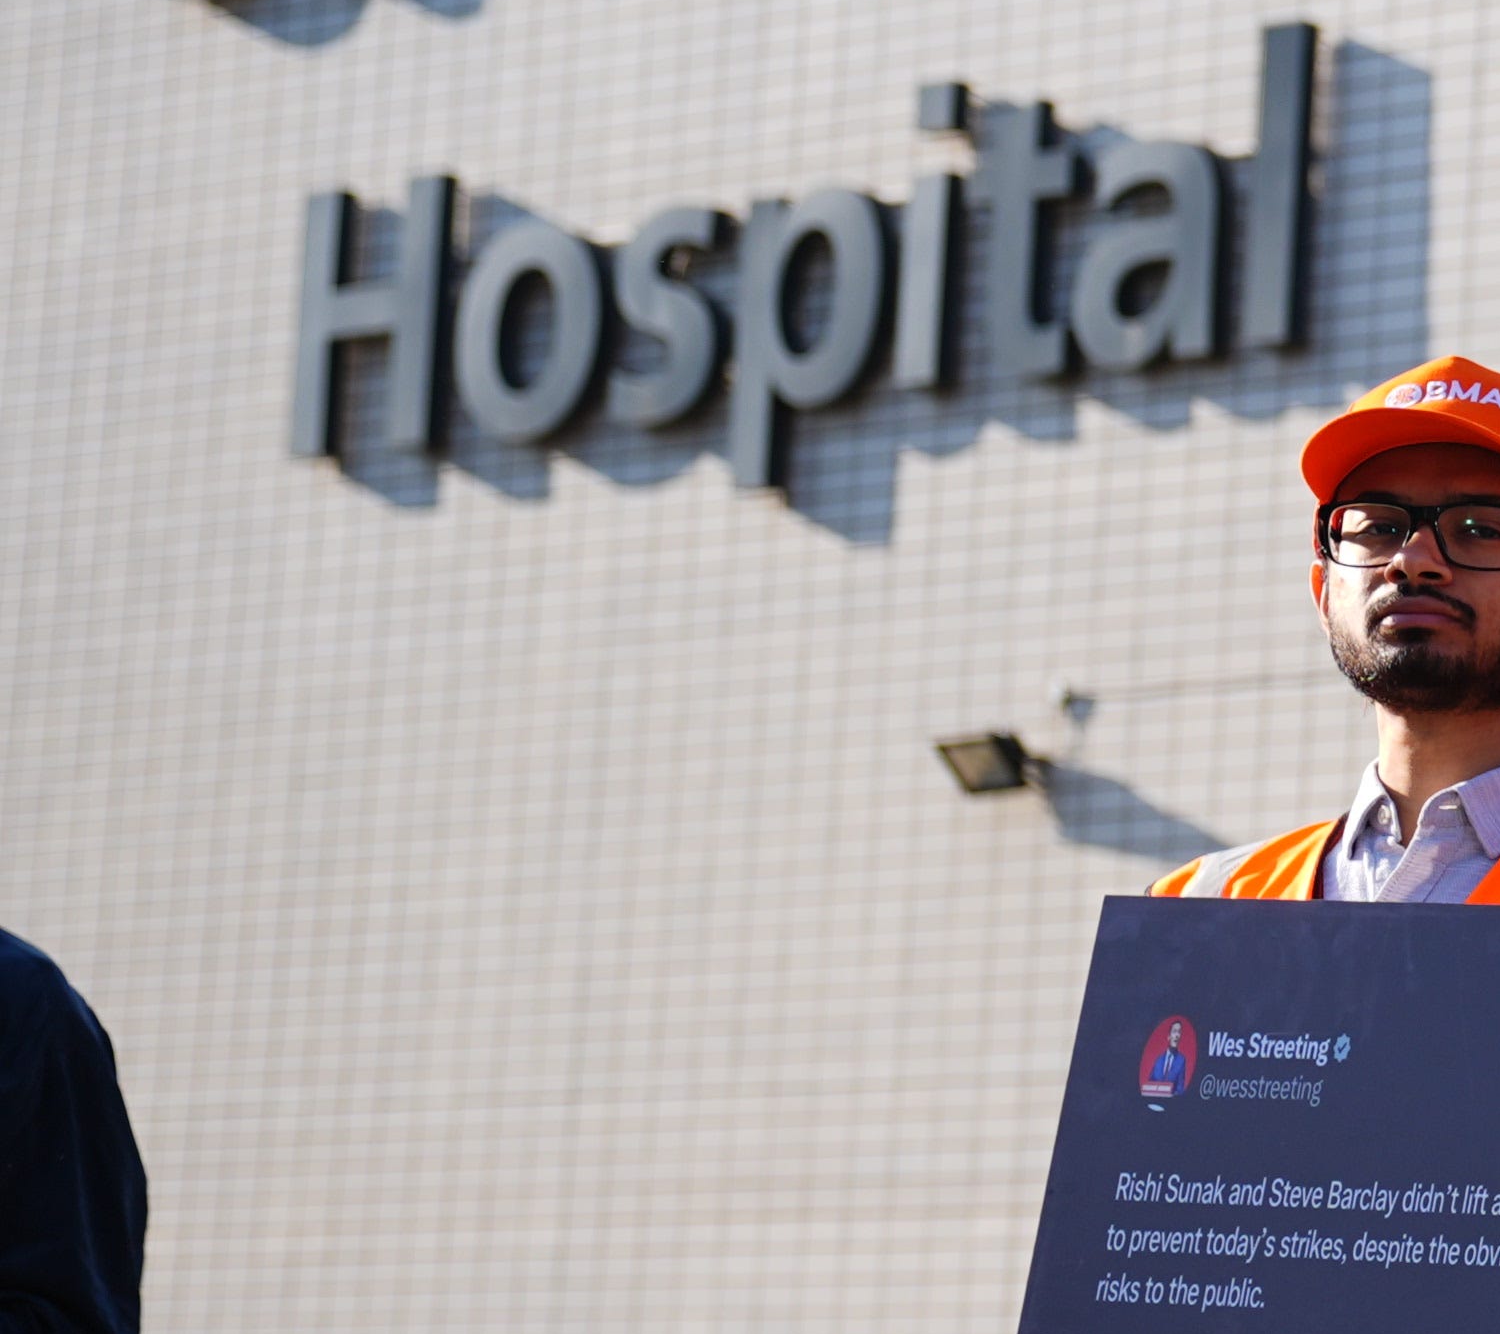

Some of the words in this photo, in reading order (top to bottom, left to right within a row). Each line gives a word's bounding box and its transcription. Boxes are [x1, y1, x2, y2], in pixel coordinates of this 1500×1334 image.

[288, 22, 1326, 491] Hospital
[1208, 1031, 1245, 1058] Wes
[1247, 1032, 1331, 1067] Streeting
[1199, 1073, 1324, 1108] @wesstreeting
[1115, 1172, 1164, 1202] Rishi
[1164, 1173, 1226, 1205] Sunak
[1228, 1176, 1267, 1207] and
[1268, 1177, 1324, 1209] Steve
[1327, 1180, 1400, 1219] Barclay
[1461, 1184, 1489, 1215] lift
[1106, 1224, 1126, 1251] to
[1127, 1227, 1203, 1258] prevent
[1278, 1229, 1347, 1265] strikes,
[1352, 1231, 1425, 1269] despite
[1428, 1234, 1461, 1265] the
[1095, 1272, 1141, 1303] risks
[1144, 1277, 1165, 1304] to
[1168, 1275, 1200, 1306] the
[1201, 1277, 1265, 1313] public.
